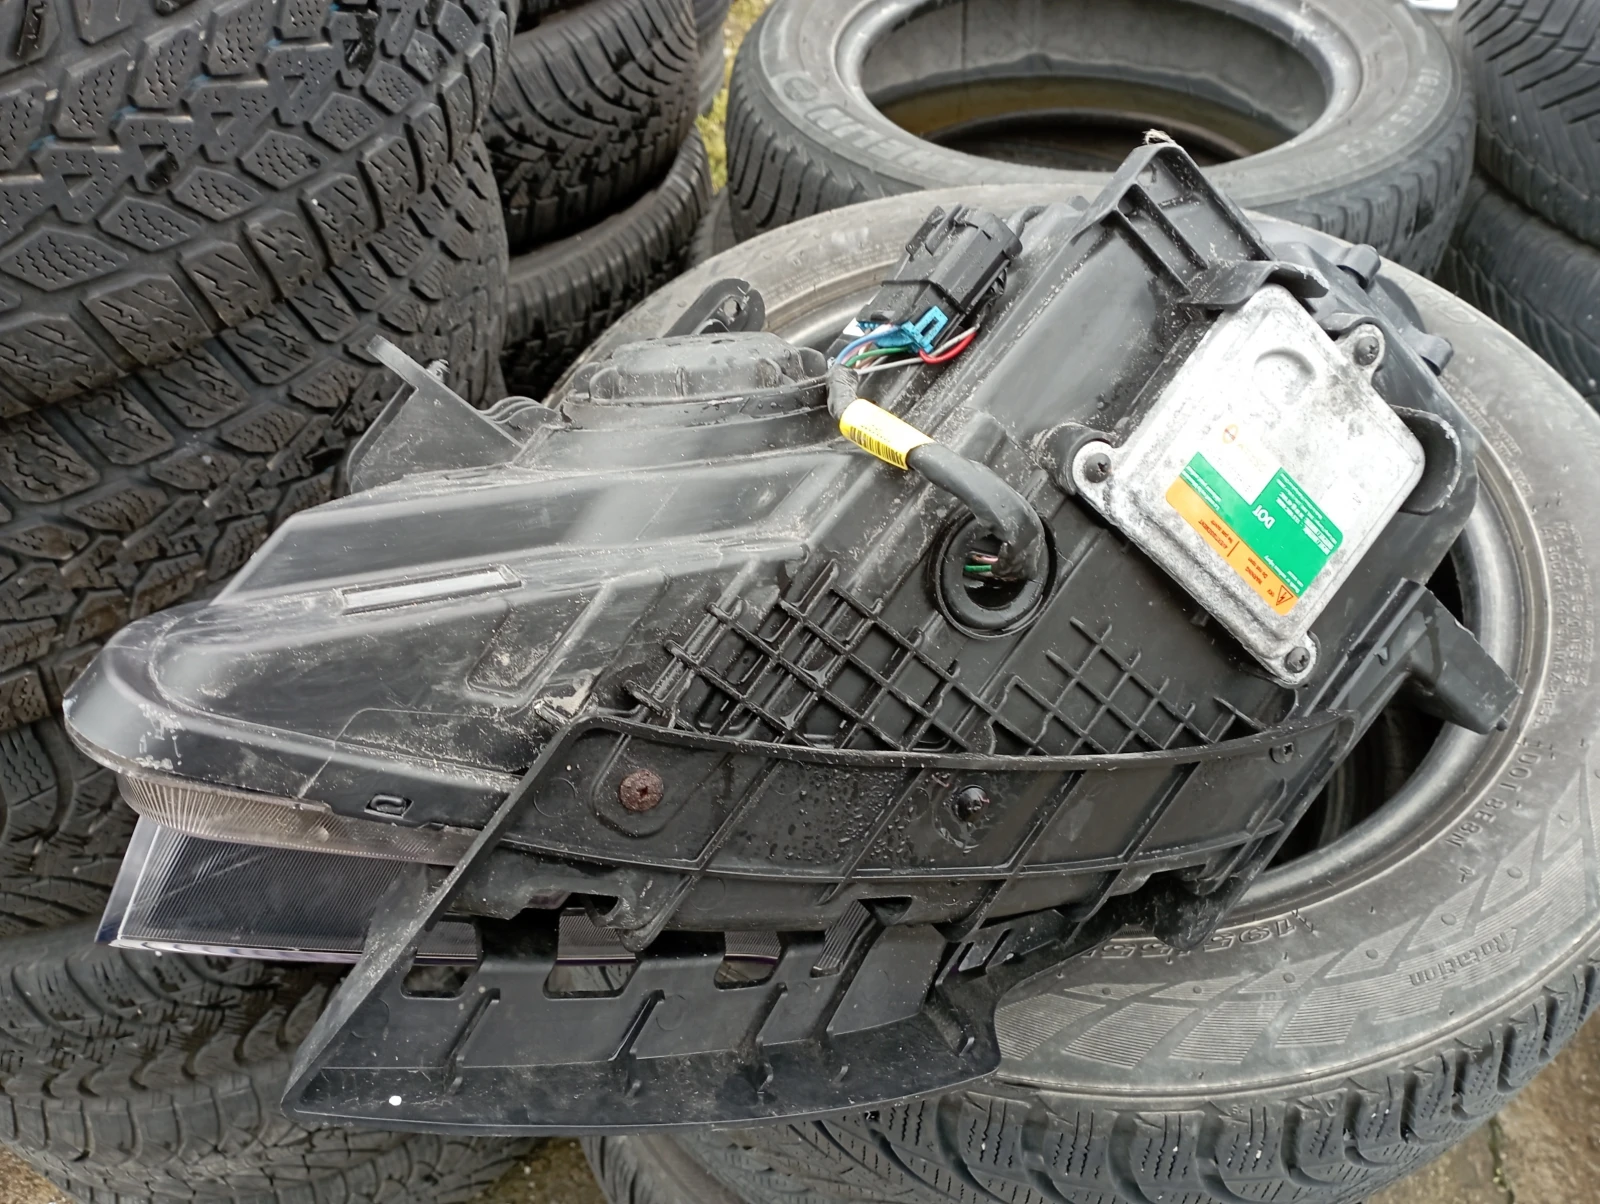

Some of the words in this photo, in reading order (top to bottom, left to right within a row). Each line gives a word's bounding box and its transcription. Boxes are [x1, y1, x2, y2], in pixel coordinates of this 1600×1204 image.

[1251, 504, 1276, 530] DOT
[1498, 752, 1542, 795] DOT
[1408, 932, 1512, 987] Rotation
